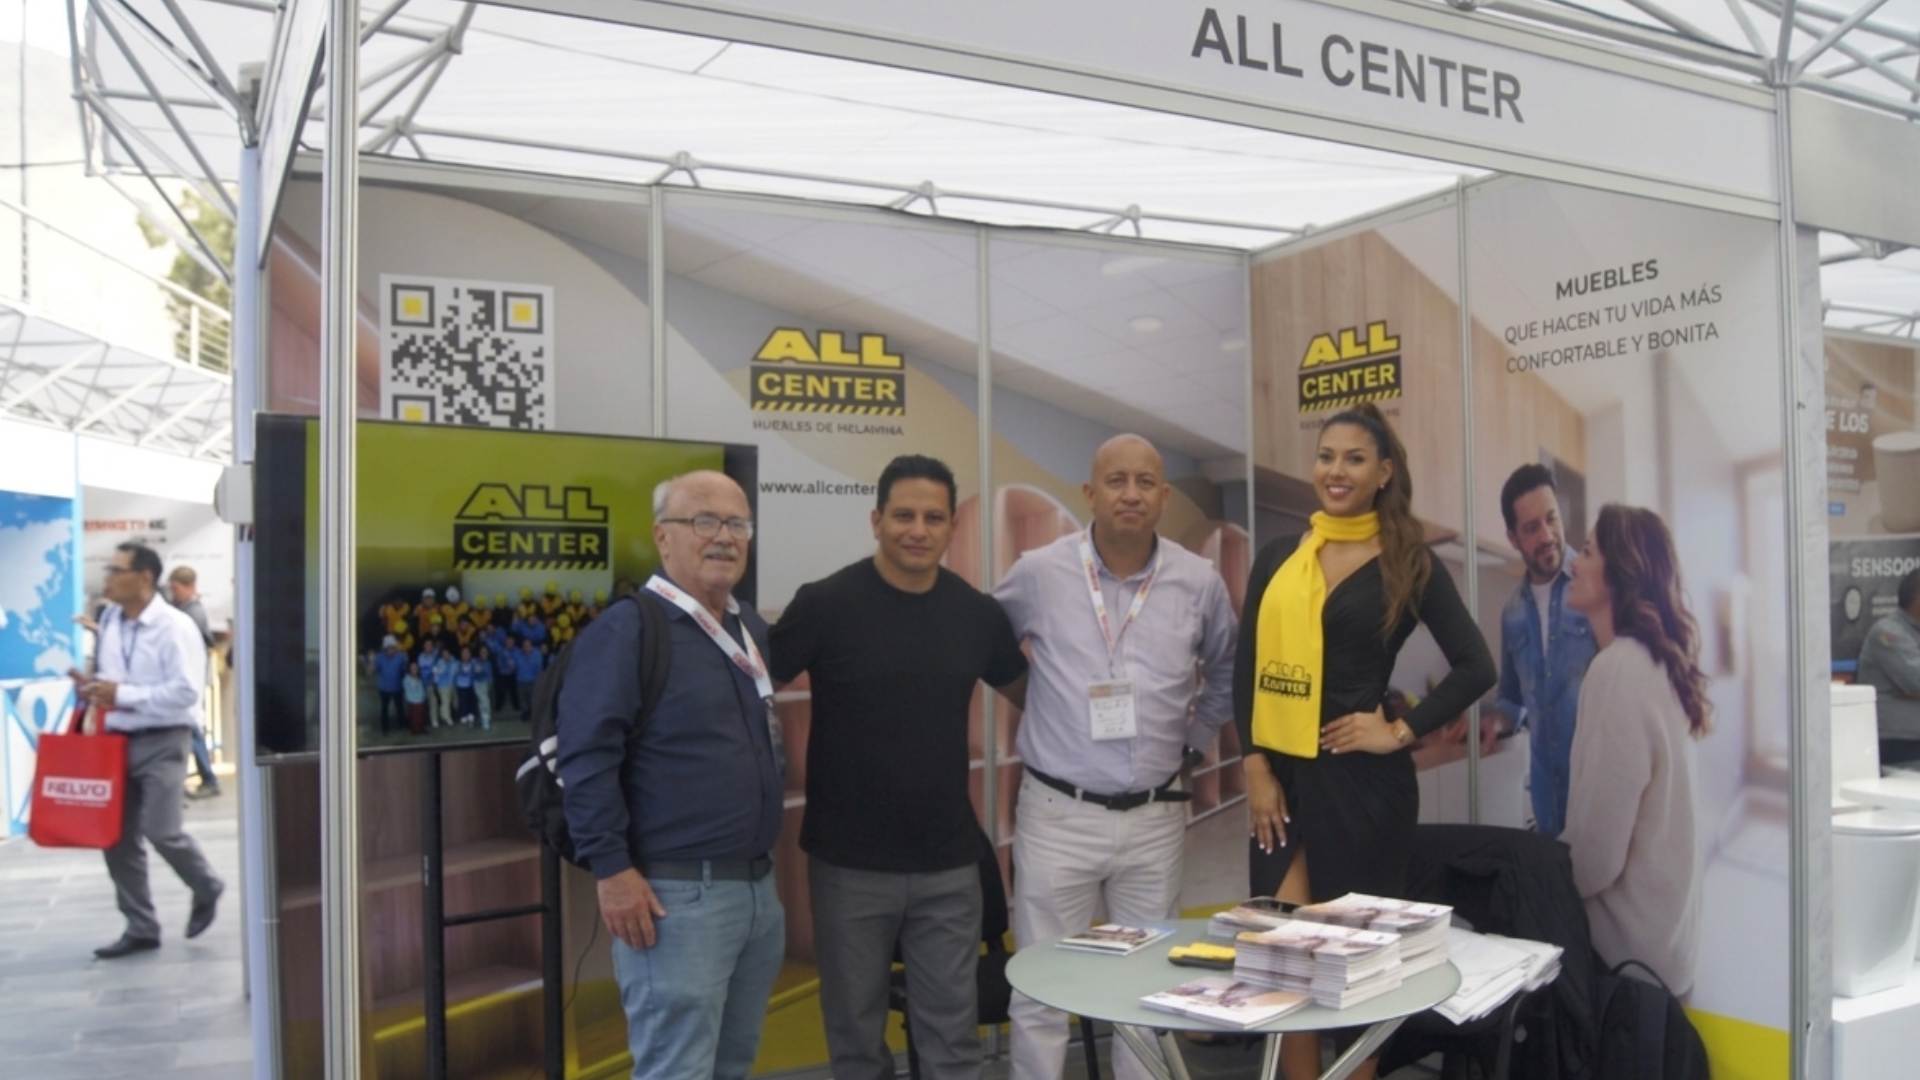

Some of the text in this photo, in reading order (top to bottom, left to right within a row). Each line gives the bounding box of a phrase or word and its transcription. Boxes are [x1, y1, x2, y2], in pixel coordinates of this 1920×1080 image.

[1191, 8, 1525, 124] ALL CENTER
[1555, 259, 1660, 300] MUEBLES
[1504, 283, 1723, 346] QUE HACEN TU VIDA MÁS
[752, 326, 905, 371] ALL
[1300, 320, 1401, 370] ALL
[1506, 321, 1720, 375] CONFORTABLE Y BONITA
[757, 371, 898, 402] CENTER
[1301, 362, 1396, 400] CENTER
[815, 421, 834, 434] DE
[454, 482, 609, 523] ALL
[461, 530, 600, 555] CENTER
